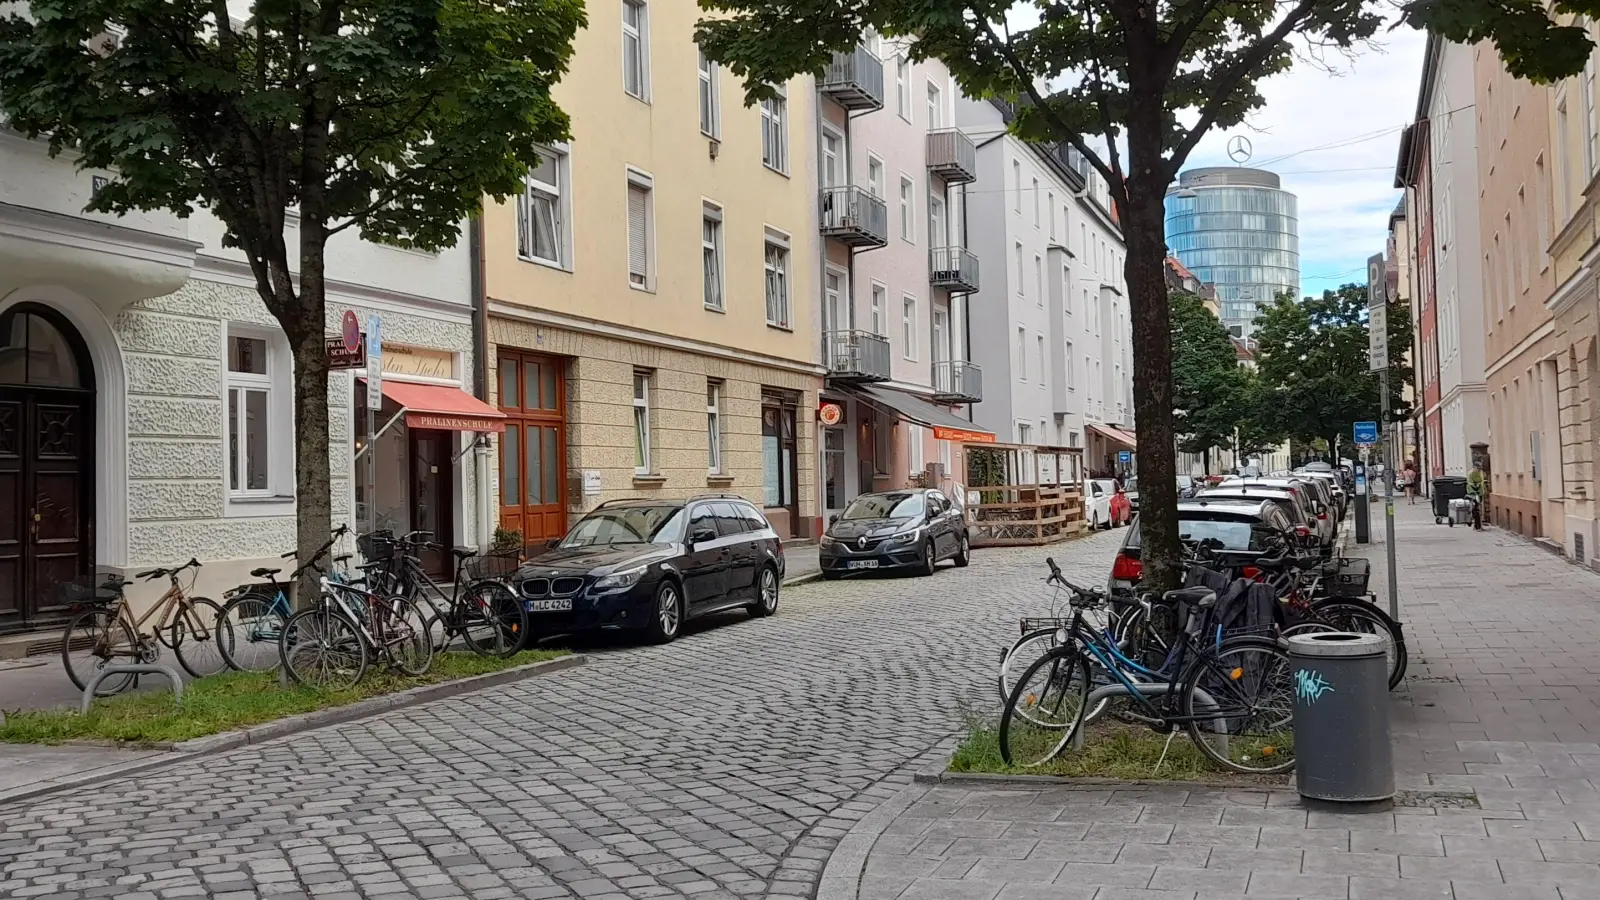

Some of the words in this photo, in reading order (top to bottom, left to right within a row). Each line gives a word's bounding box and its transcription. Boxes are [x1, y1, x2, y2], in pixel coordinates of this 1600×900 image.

[420, 416, 493, 429] PRALINENSCHULE
[539, 601, 550, 610] LC
[551, 600, 571, 610] 4242
